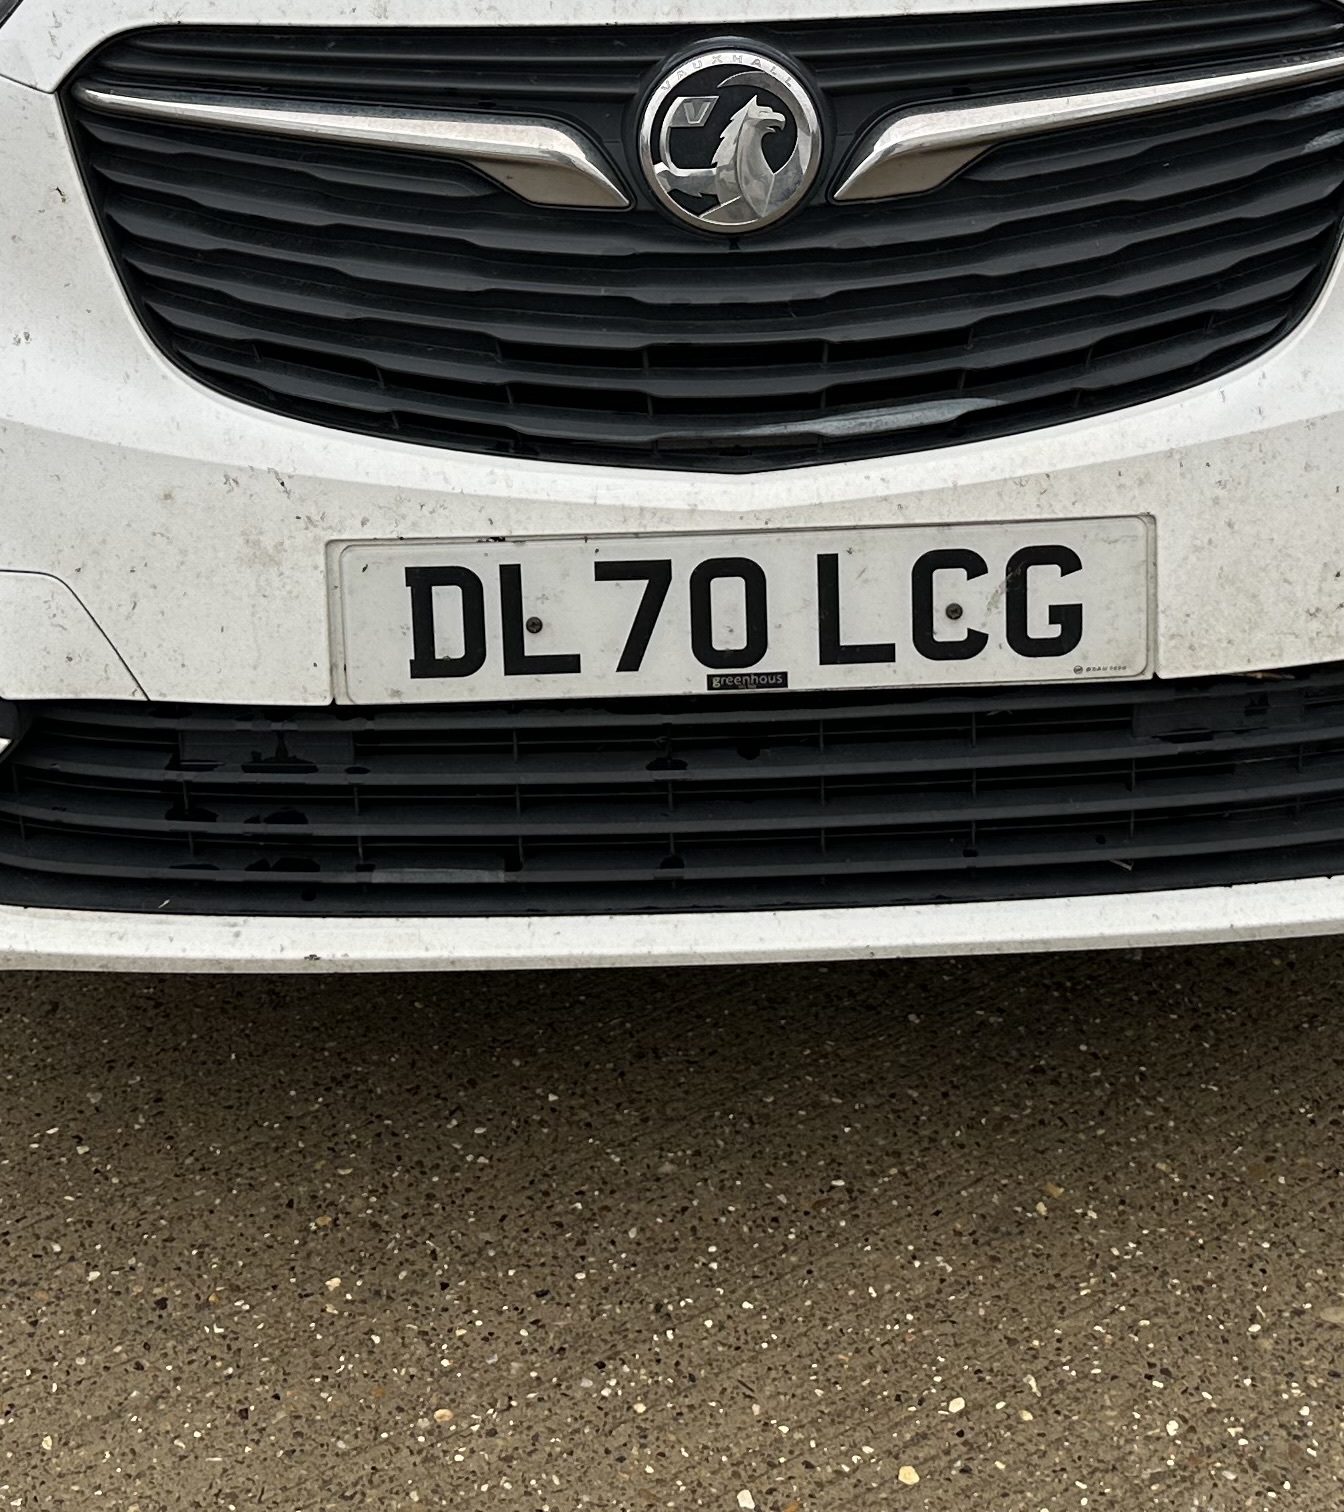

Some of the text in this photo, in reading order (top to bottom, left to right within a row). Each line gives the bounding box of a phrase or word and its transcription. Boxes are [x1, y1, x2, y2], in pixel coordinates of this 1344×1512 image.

[661, 54, 793, 91] VAUXHALL
[404, 543, 1085, 679] DL70 LCG
[712, 673, 783, 688] greenhous
